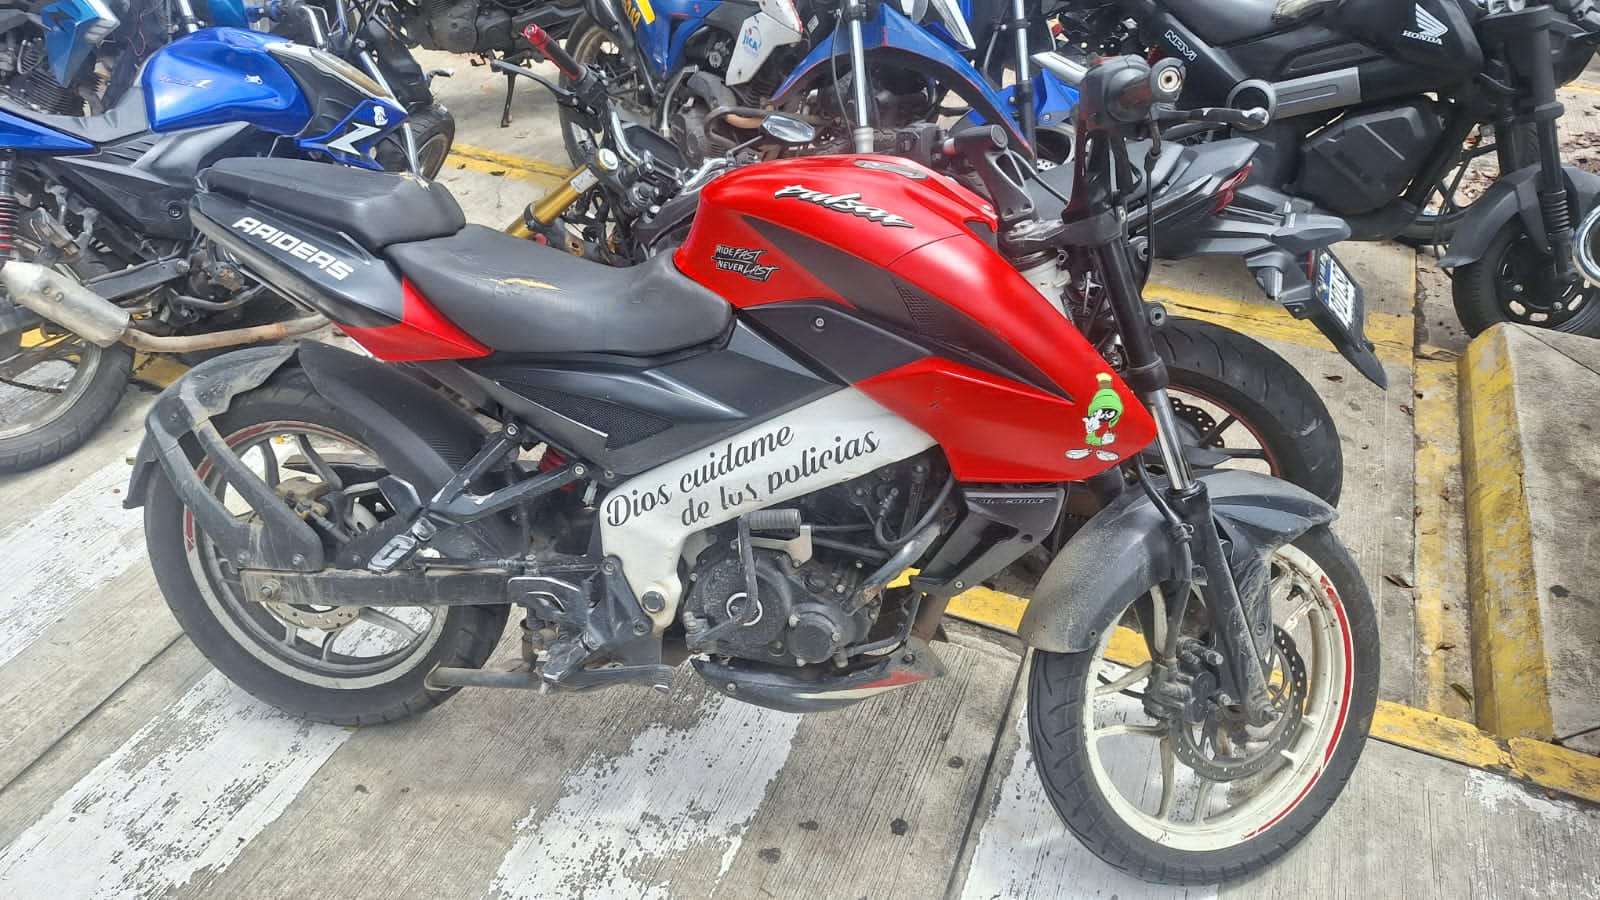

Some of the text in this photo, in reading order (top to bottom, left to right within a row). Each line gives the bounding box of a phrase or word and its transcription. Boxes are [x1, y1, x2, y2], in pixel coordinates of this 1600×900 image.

[1164, 29, 1197, 61] NAVI
[1402, 30, 1442, 45] HONDA
[232, 216, 354, 281] RAIDERS
[716, 245, 768, 261] RIDE FAST
[718, 260, 780, 281] NEVER LAST
[606, 426, 795, 527] Dios cuidame
[681, 498, 711, 526] de
[767, 431, 880, 494] policias
